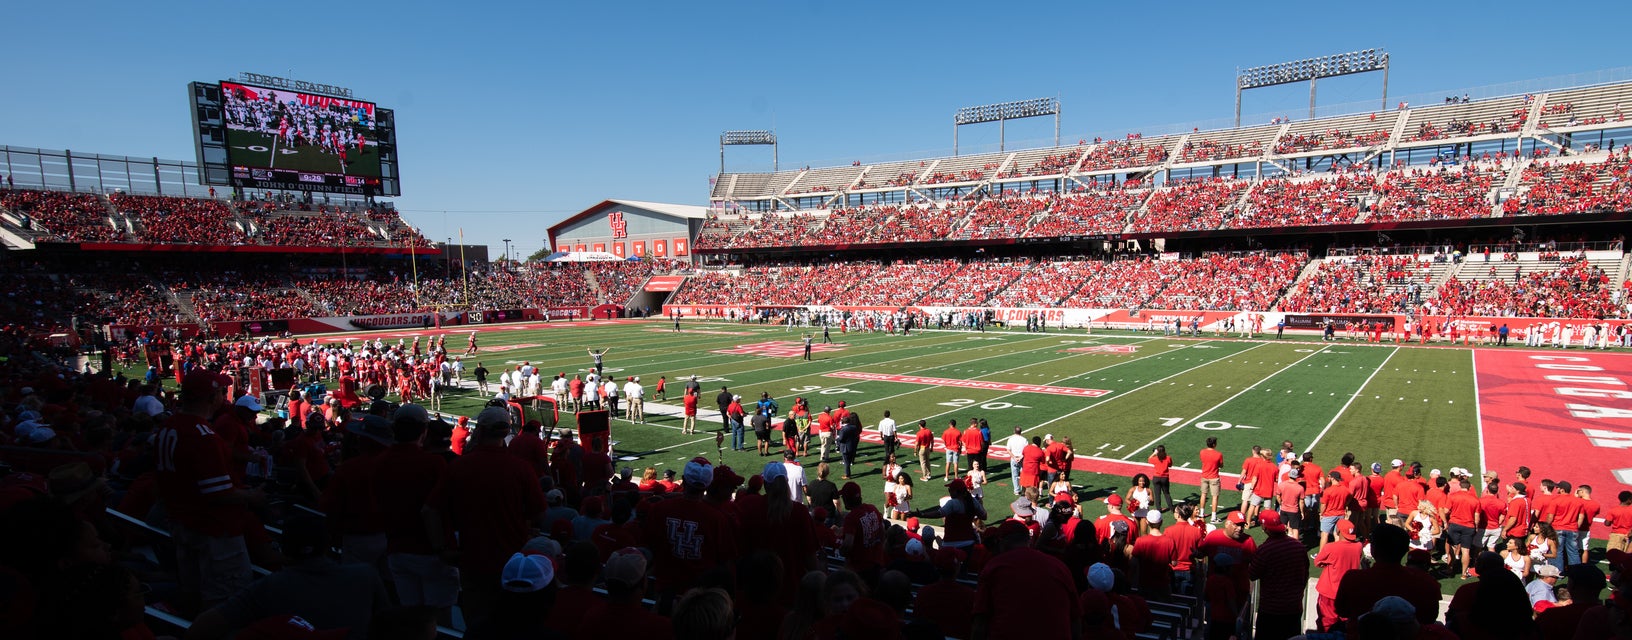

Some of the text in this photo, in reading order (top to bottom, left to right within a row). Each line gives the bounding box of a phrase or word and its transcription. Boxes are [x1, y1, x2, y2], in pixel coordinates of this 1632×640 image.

[246, 73, 349, 97] TDECU STADIUM
[256, 181, 287, 189] JOHN
[288, 183, 332, 192] O'QUINN
[334, 186, 364, 194] FIELD
[469, 312, 482, 322] 40
[790, 385, 850, 395] 30
[937, 398, 1013, 410] 20
[1159, 417, 1233, 431] 10
[157, 427, 177, 471] 10
[666, 517, 704, 560] UH
